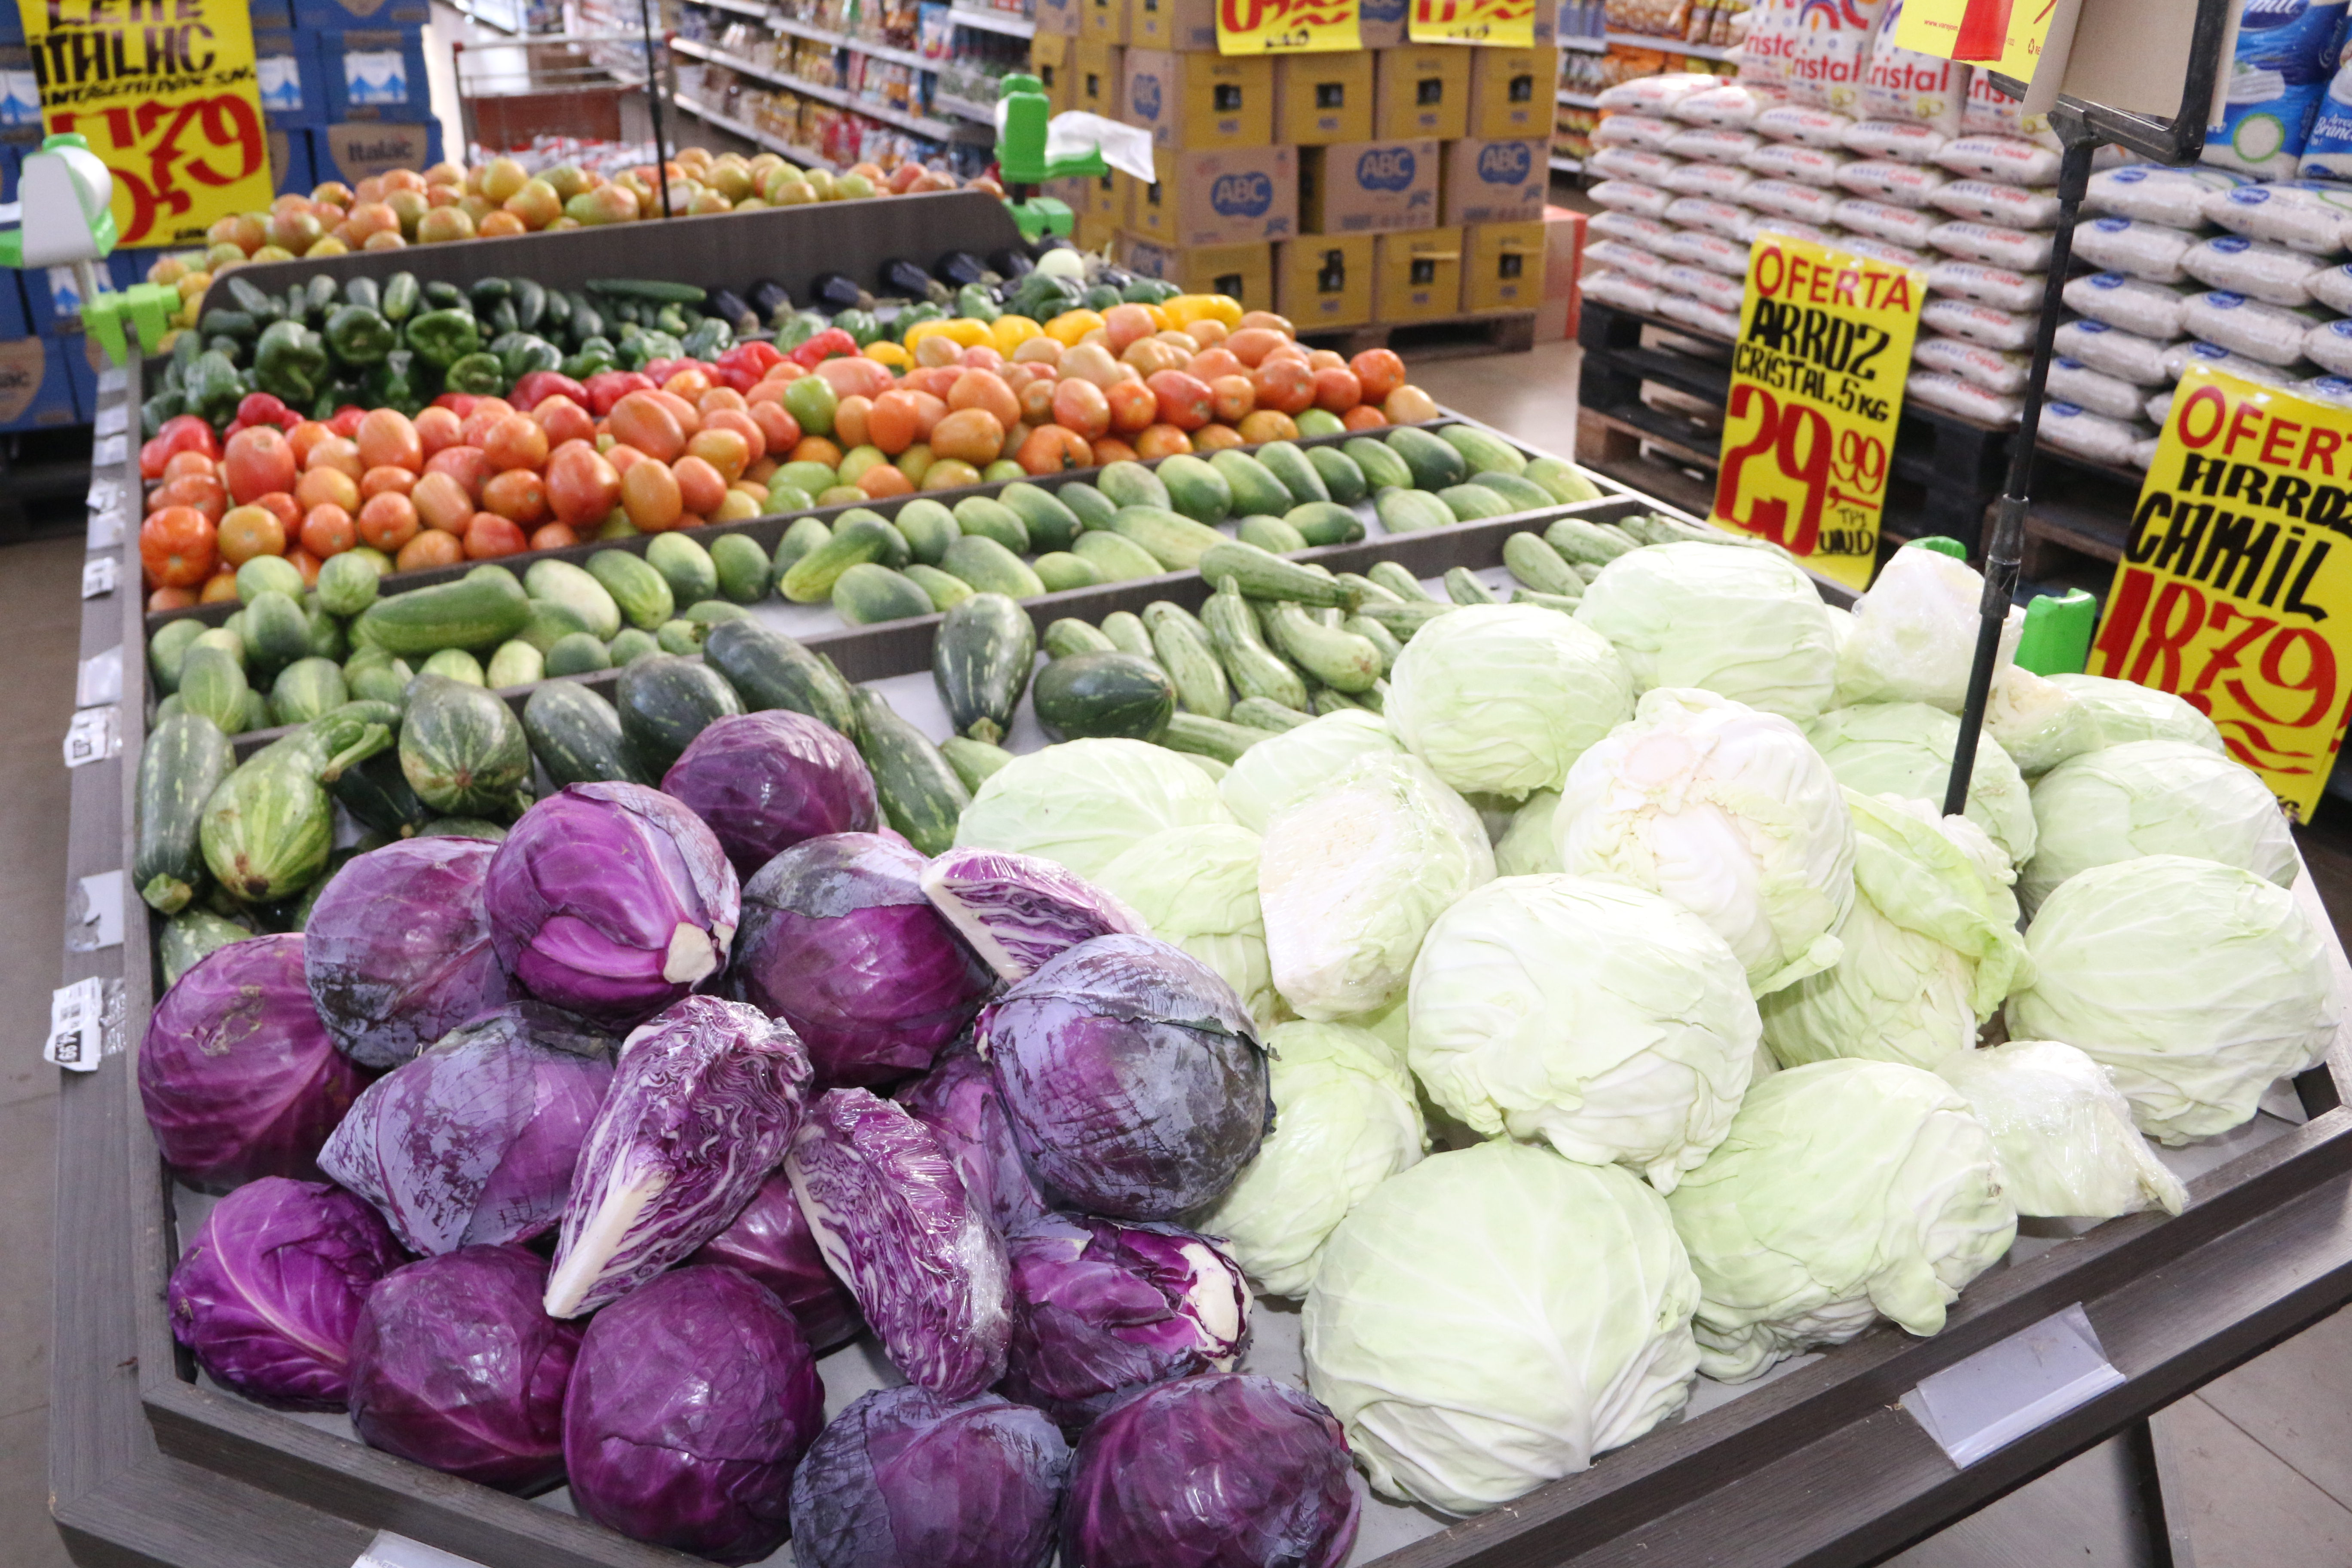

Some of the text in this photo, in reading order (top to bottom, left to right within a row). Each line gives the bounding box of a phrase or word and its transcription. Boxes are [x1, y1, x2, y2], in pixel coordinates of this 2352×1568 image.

[1362, 151, 1410, 179] ABC
[1482, 147, 1526, 173] ABC
[1216, 177, 1267, 204] ABC
[1755, 246, 1910, 312] OFERTA
[1749, 297, 1890, 380] ARROZ
[2178, 385, 2352, 481] OFER
